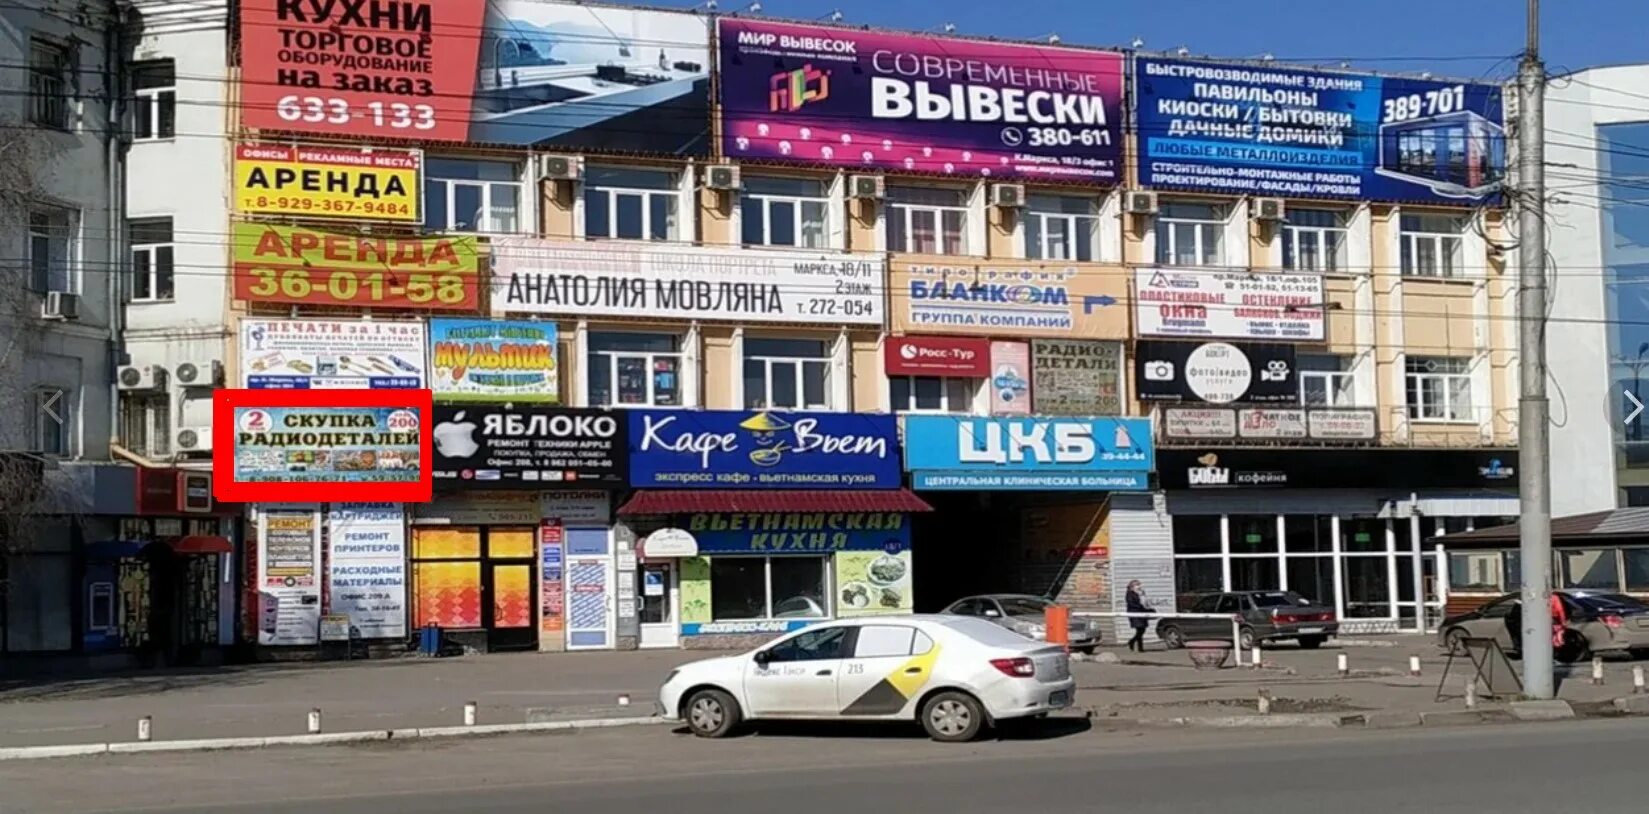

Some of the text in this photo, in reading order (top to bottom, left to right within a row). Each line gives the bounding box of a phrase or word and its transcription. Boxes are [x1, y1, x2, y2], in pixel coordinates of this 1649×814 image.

[277, 0, 433, 33] КУХНИ
[277, 28, 433, 59] ТОРГОВОЕ
[738, 31, 857, 54] МИР ВЫВЕСОК
[277, 50, 433, 75] ОБОРУДОВАНИЕ
[872, 49, 1100, 93] СОВРЕМЕННЫЕ
[277, 68, 434, 98] на заказ
[1145, 63, 1363, 92] БЫСТРОВОЗВОДИМЫЕ ЗДАНИЯ
[870, 76, 1107, 126] ВЫВЕСКИ
[1193, 83, 1318, 108] ПАВИЛЬОНЫ
[277, 95, 436, 130] 633-133
[1158, 99, 1239, 120] КИОСКИ
[1258, 107, 1353, 128] БЫТОВКИ
[1027, 126, 1111, 147] 380-611
[1168, 119, 1344, 146] ДАЧНЫЕ ДОМИКИ
[243, 149, 414, 168] ОФИСЫ РЕКЛАМНЫЕ МЕСТА
[1154, 141, 1360, 167] ЛЮБЫЕ МЕТАЛЛОИЗДЕЛИЯ
[246, 167, 407, 199] АРЕНДА
[1152, 162, 1361, 184] СТРОИТЕЛЬНО-МОНТАЖНЫЕ РАБОТЫ
[1152, 173, 1361, 196] ПРОЕКТИРОВАНИЕ/ФАСАДЫ/КРОВЛИ
[254, 231, 461, 267] АРЕНДА
[911, 266, 1065, 283] типорафия
[249, 269, 466, 304] 36-01-58
[506, 272, 783, 314] АНАТОЛИЯ МОВЛЯНА
[836, 279, 843, 295] 2
[809, 298, 873, 316] 272-054
[1140, 290, 1226, 304] ПЛАСТИКОВЫЕ
[1242, 294, 1312, 307] ОСТЕКЛЕНИЕ
[267, 322, 344, 333] ПЕЧАТИ
[349, 324, 369, 333] за
[388, 326, 419, 335] час
[912, 312, 1071, 329] ГРУППА КОМПАНИЙ
[1035, 357, 1116, 370] ДЕТАЛИ
[248, 411, 264, 426] 2
[283, 414, 376, 428] СКУПКА
[389, 417, 416, 428] 200
[482, 413, 617, 438] ЯБЛОКО
[238, 429, 420, 447] РАДИОДЕТАЛЕЙ
[487, 439, 612, 449] РЕМОНТ ТЕХНИКИ APPLE
[640, 415, 887, 468] Кафе Вьет
[959, 421, 1096, 465] ЦКБ
[655, 472, 714, 484] экспресс
[716, 472, 750, 484] кафе
[758, 475, 838, 484] вьетнамская
[840, 475, 876, 486] кухня
[924, 474, 1138, 488] ЦЕНТРАЛЬНАЯ КЛИНИЧЕСКАЯ БОЛЬНИЦА
[1238, 471, 1287, 485] кофейня
[690, 513, 902, 531] ВЬЕТНАМСКАЯ
[344, 532, 390, 541] РЕМОНТ
[750, 532, 848, 549] КУХНЯ
[334, 544, 400, 553] ПРИНТЕРОВ
[333, 566, 402, 576] РАСХОДНЫЕ
[332, 578, 402, 587] МАТЕРИАЛЫ
